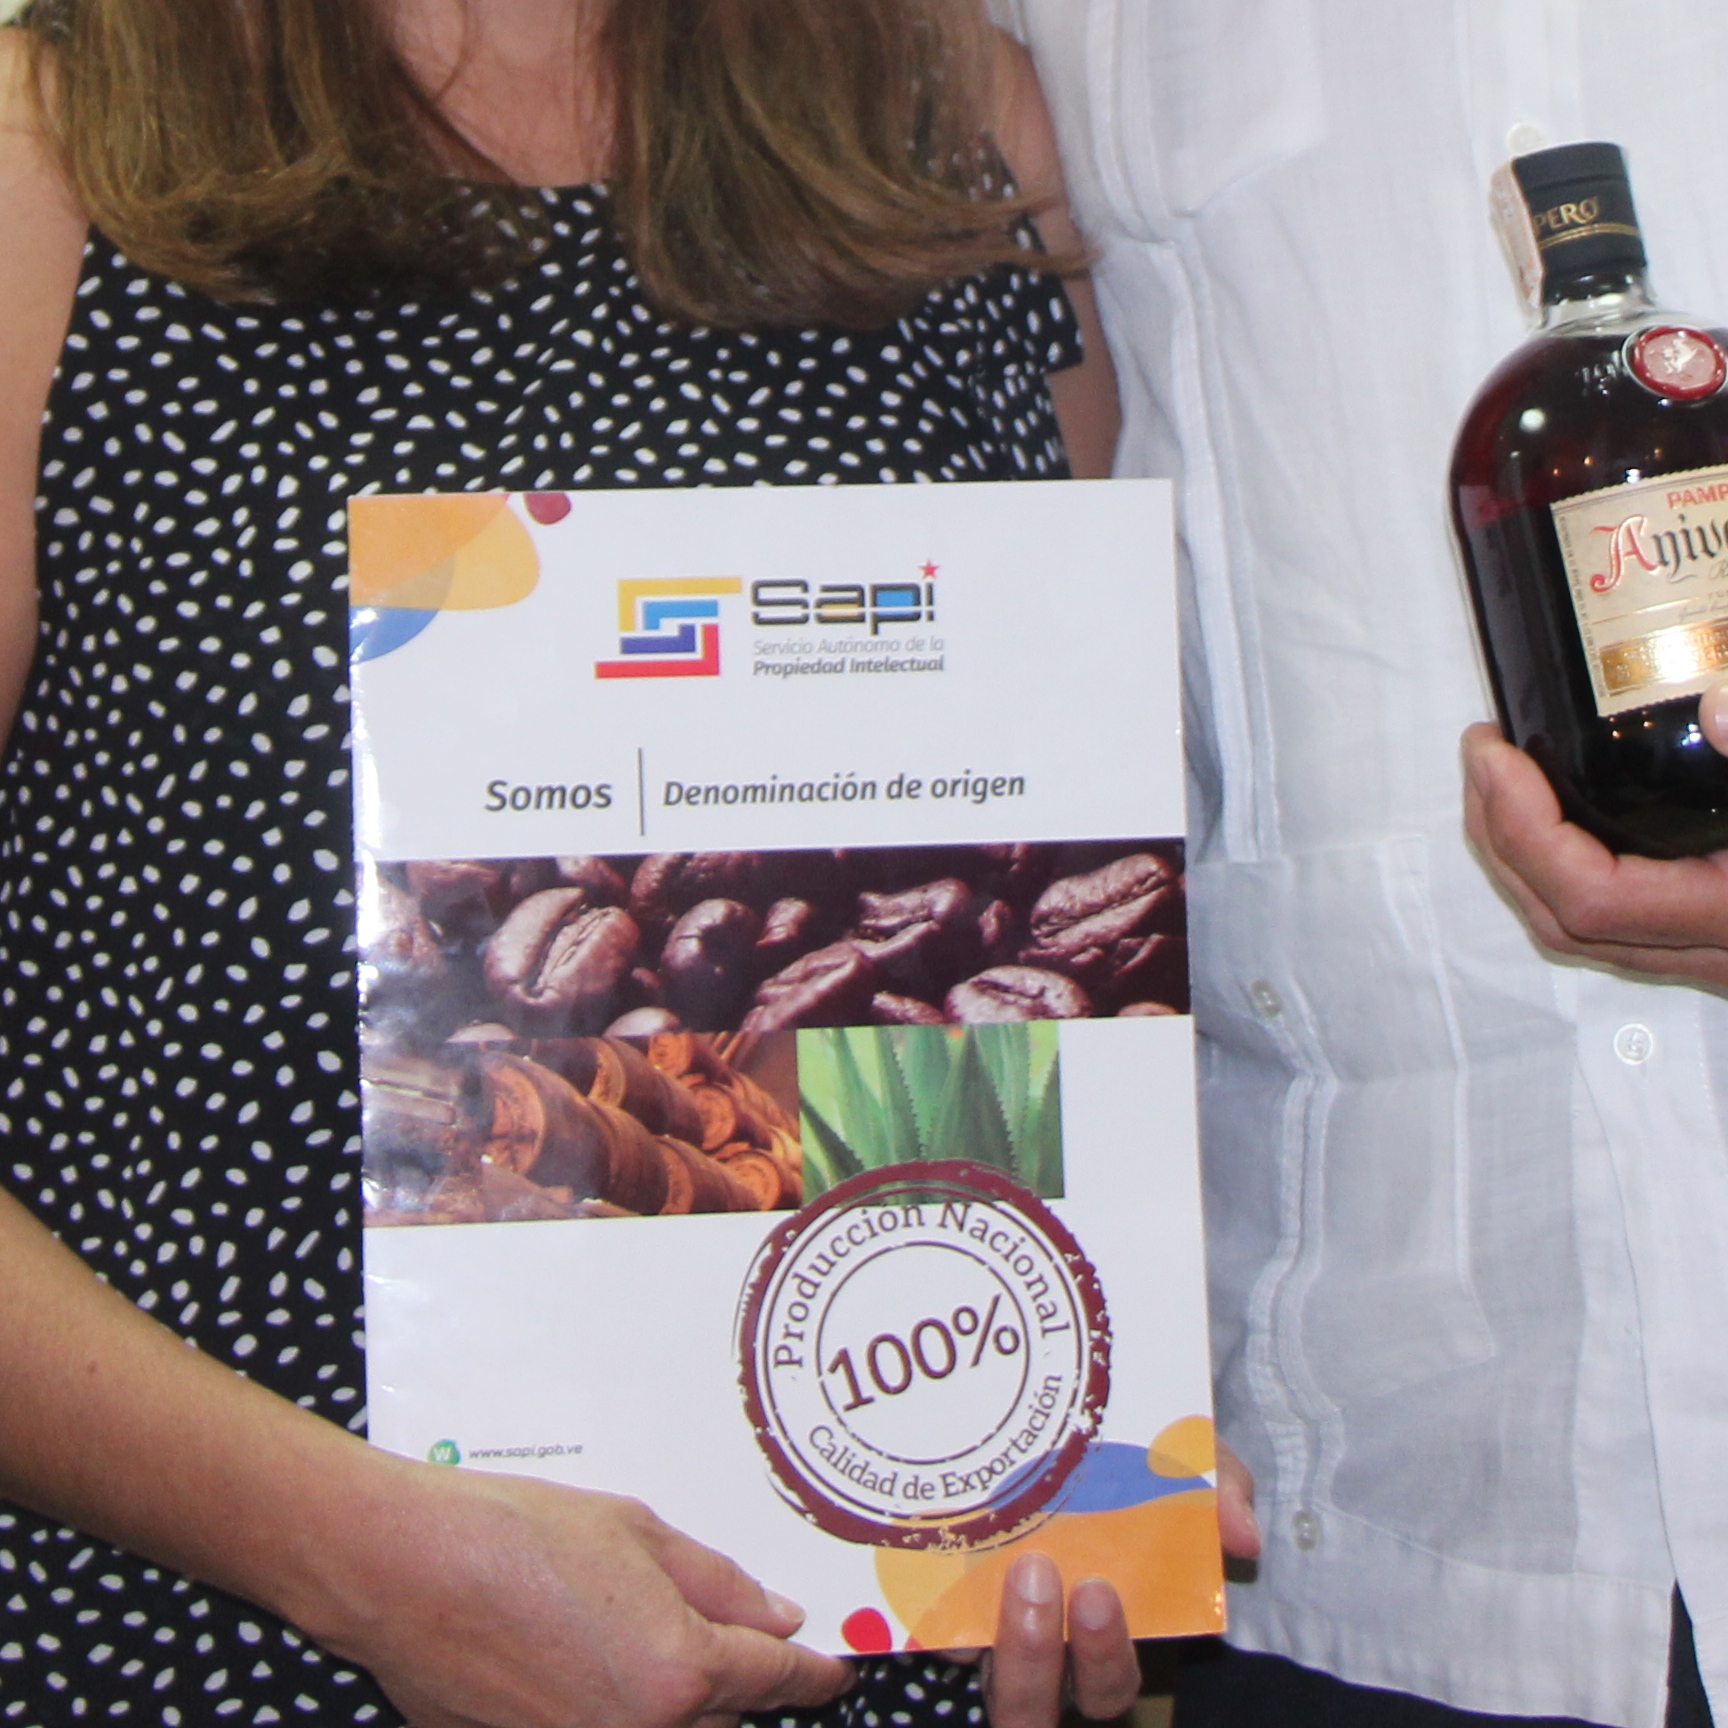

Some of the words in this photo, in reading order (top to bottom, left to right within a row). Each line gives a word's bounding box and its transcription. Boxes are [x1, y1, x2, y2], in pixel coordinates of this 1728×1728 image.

[1534, 197, 1600, 235] PERO
[752, 560, 940, 635] Sapi
[753, 638, 813, 656] Servicio
[817, 636, 900, 655] Autónomo
[905, 635, 924, 652] de
[929, 634, 944, 652] la
[753, 656, 845, 678] Propiedad
[850, 653, 945, 674] Intelectual
[485, 779, 612, 812] Somos
[663, 771, 876, 806] Denominación
[887, 773, 921, 800] de
[931, 768, 1024, 804] origen
[937, 1201, 1070, 1338] Nacional
[828, 1293, 1020, 1411] 100%
[809, 1425, 897, 1496] Calidad
[902, 1478, 935, 1500] de
[939, 1374, 1061, 1498] Exportación
